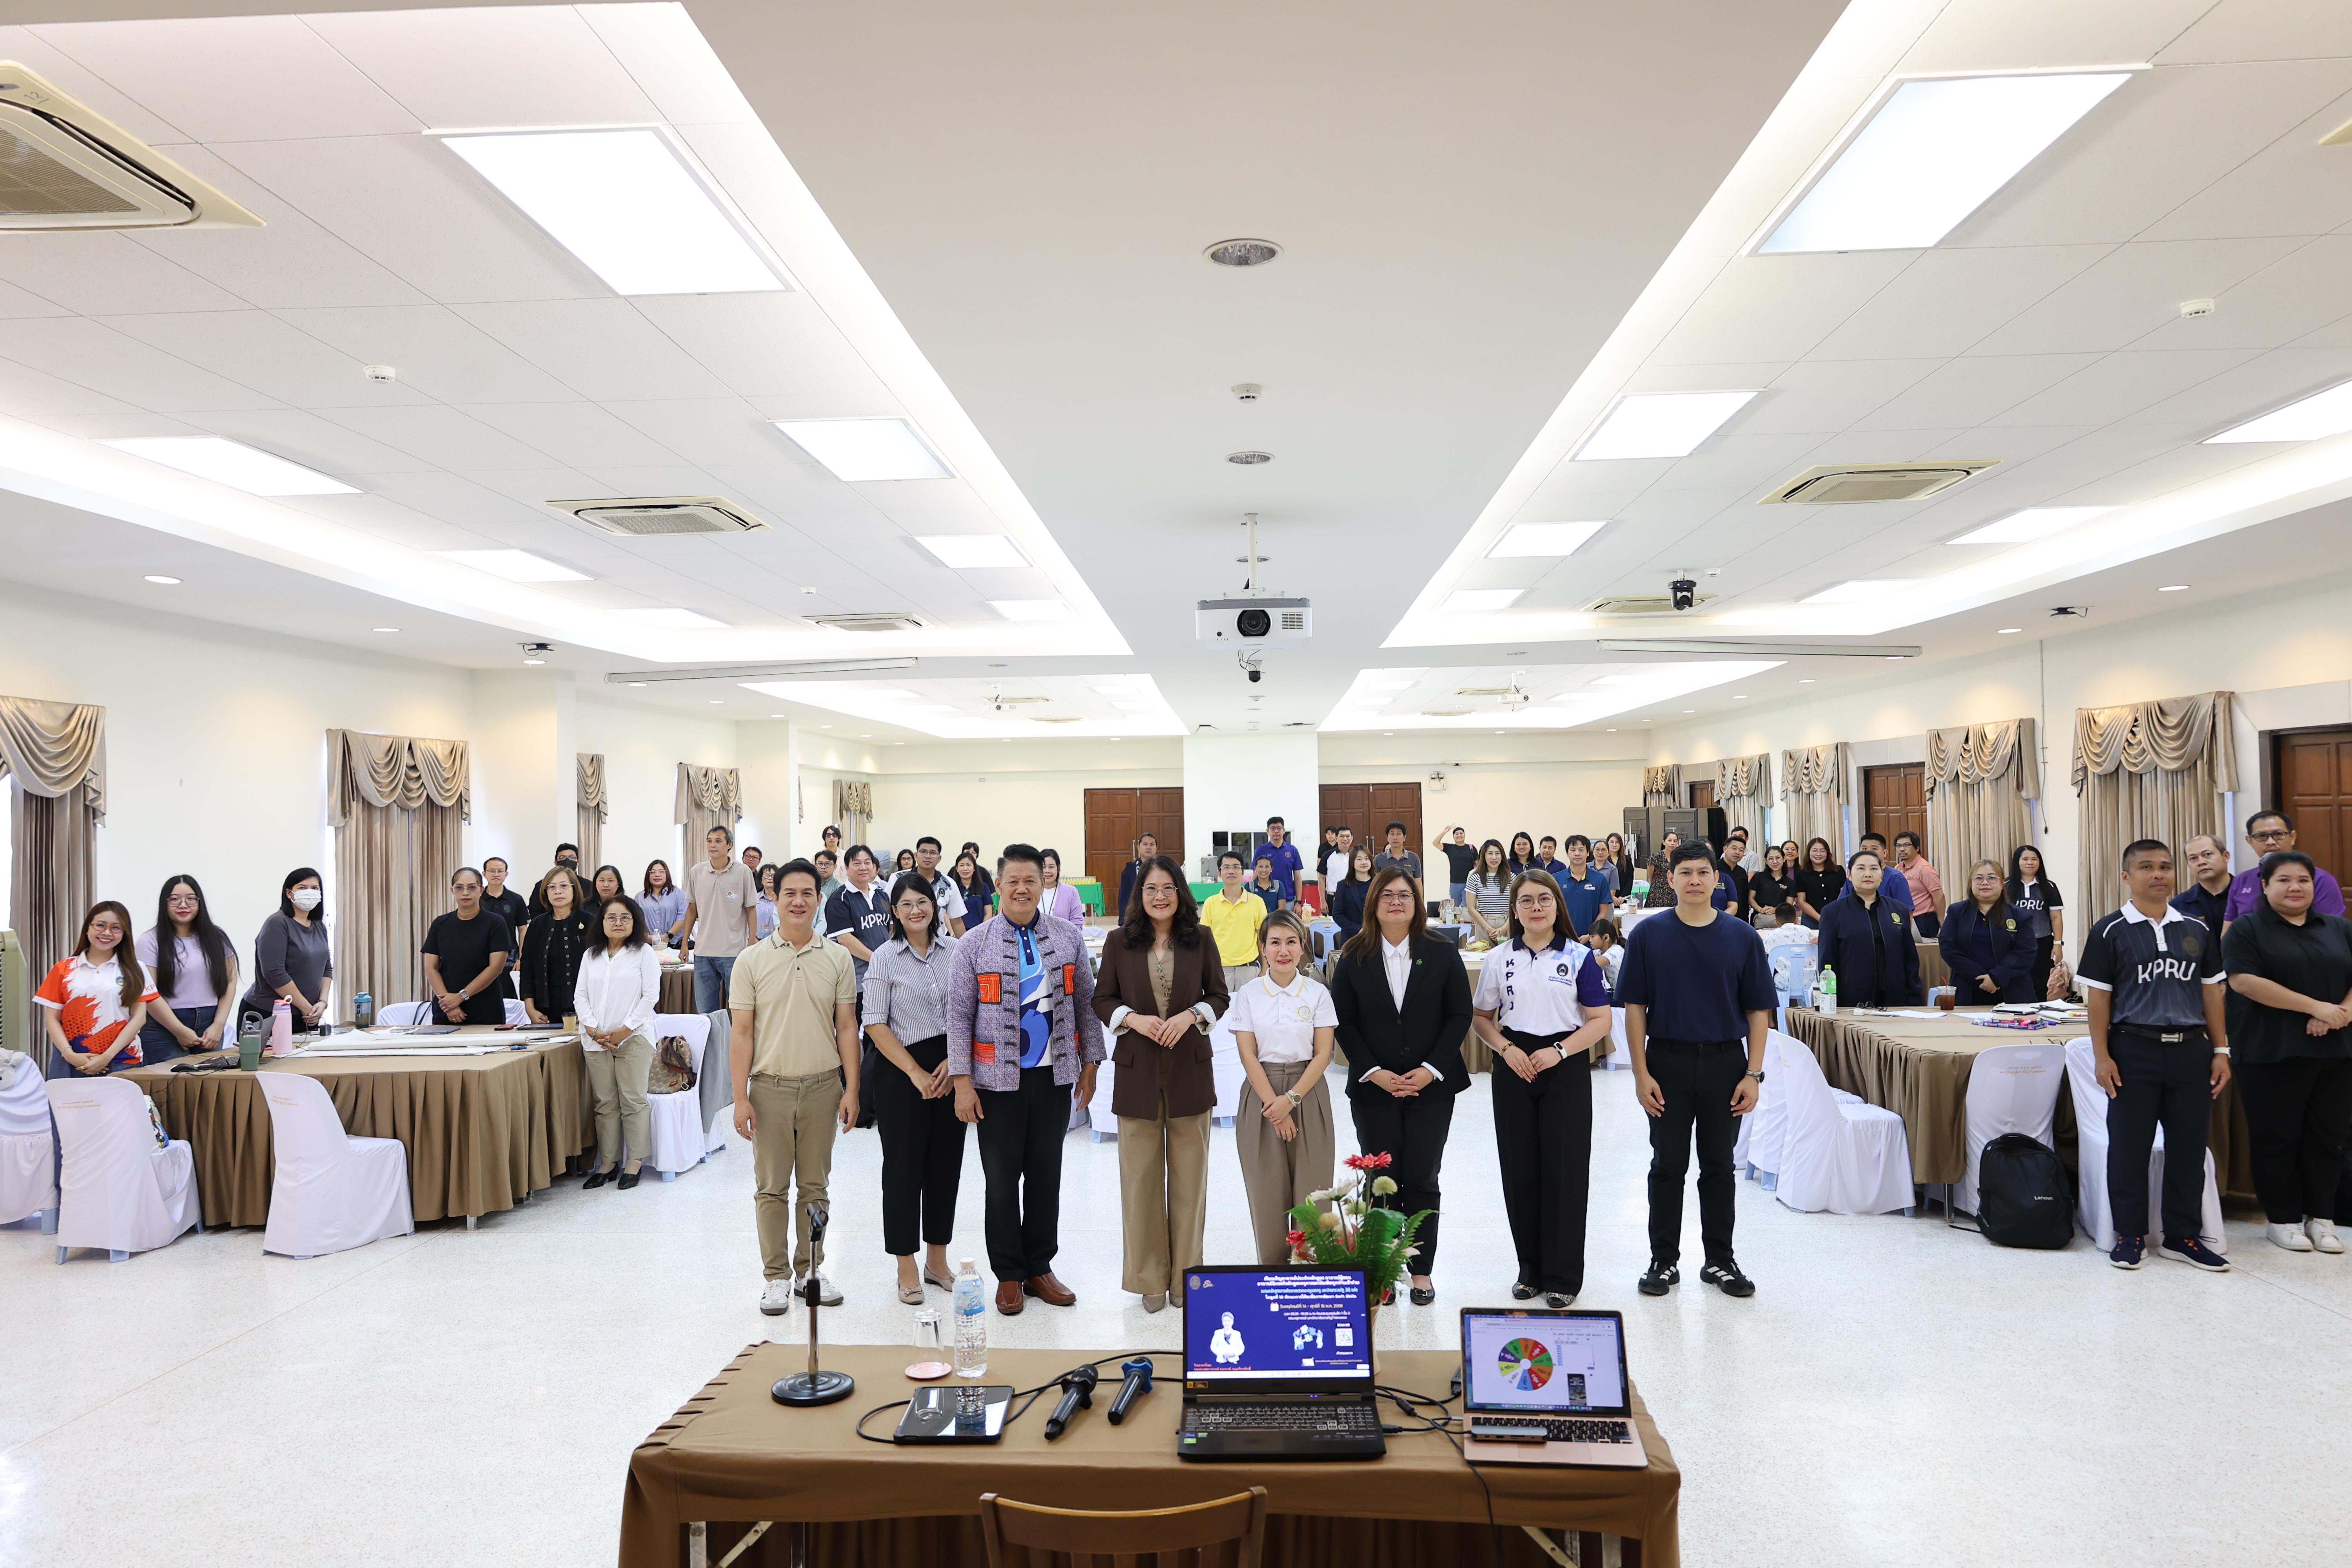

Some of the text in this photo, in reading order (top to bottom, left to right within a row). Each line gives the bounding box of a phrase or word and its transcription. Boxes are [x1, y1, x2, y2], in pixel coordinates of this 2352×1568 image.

[2016, 899, 2044, 910] PRU
[860, 913, 890, 930] KPRU
[2138, 958, 2196, 984] KPRU
